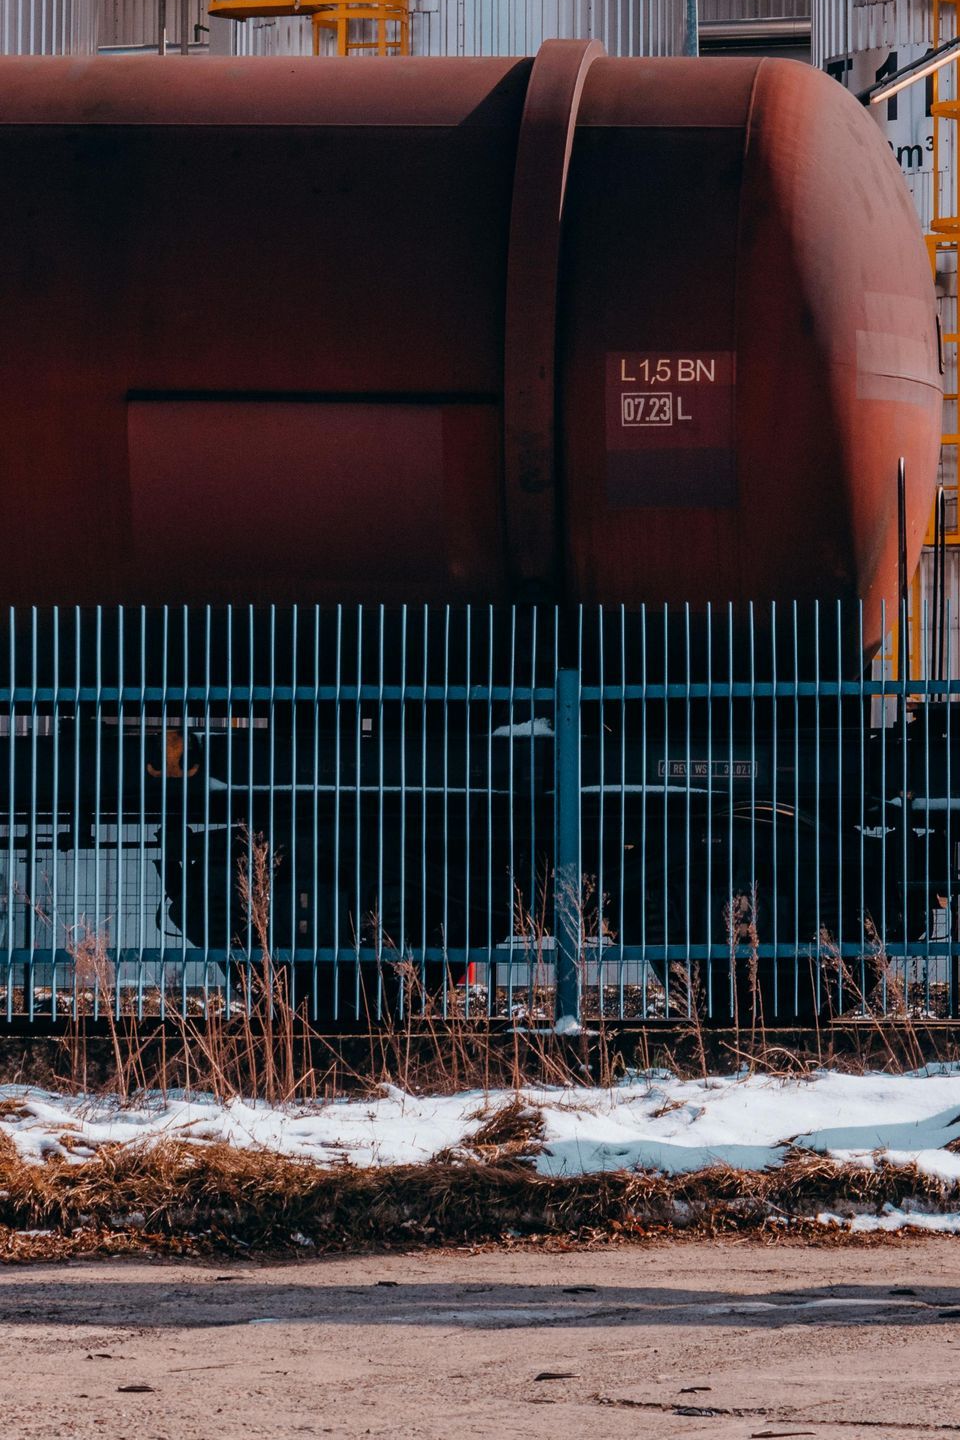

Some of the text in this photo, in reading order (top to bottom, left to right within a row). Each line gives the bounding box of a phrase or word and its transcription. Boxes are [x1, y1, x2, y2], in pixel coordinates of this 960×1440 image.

[621, 359, 715, 385] L 1,5 BN
[624, 396, 693, 421] 07.23 L
